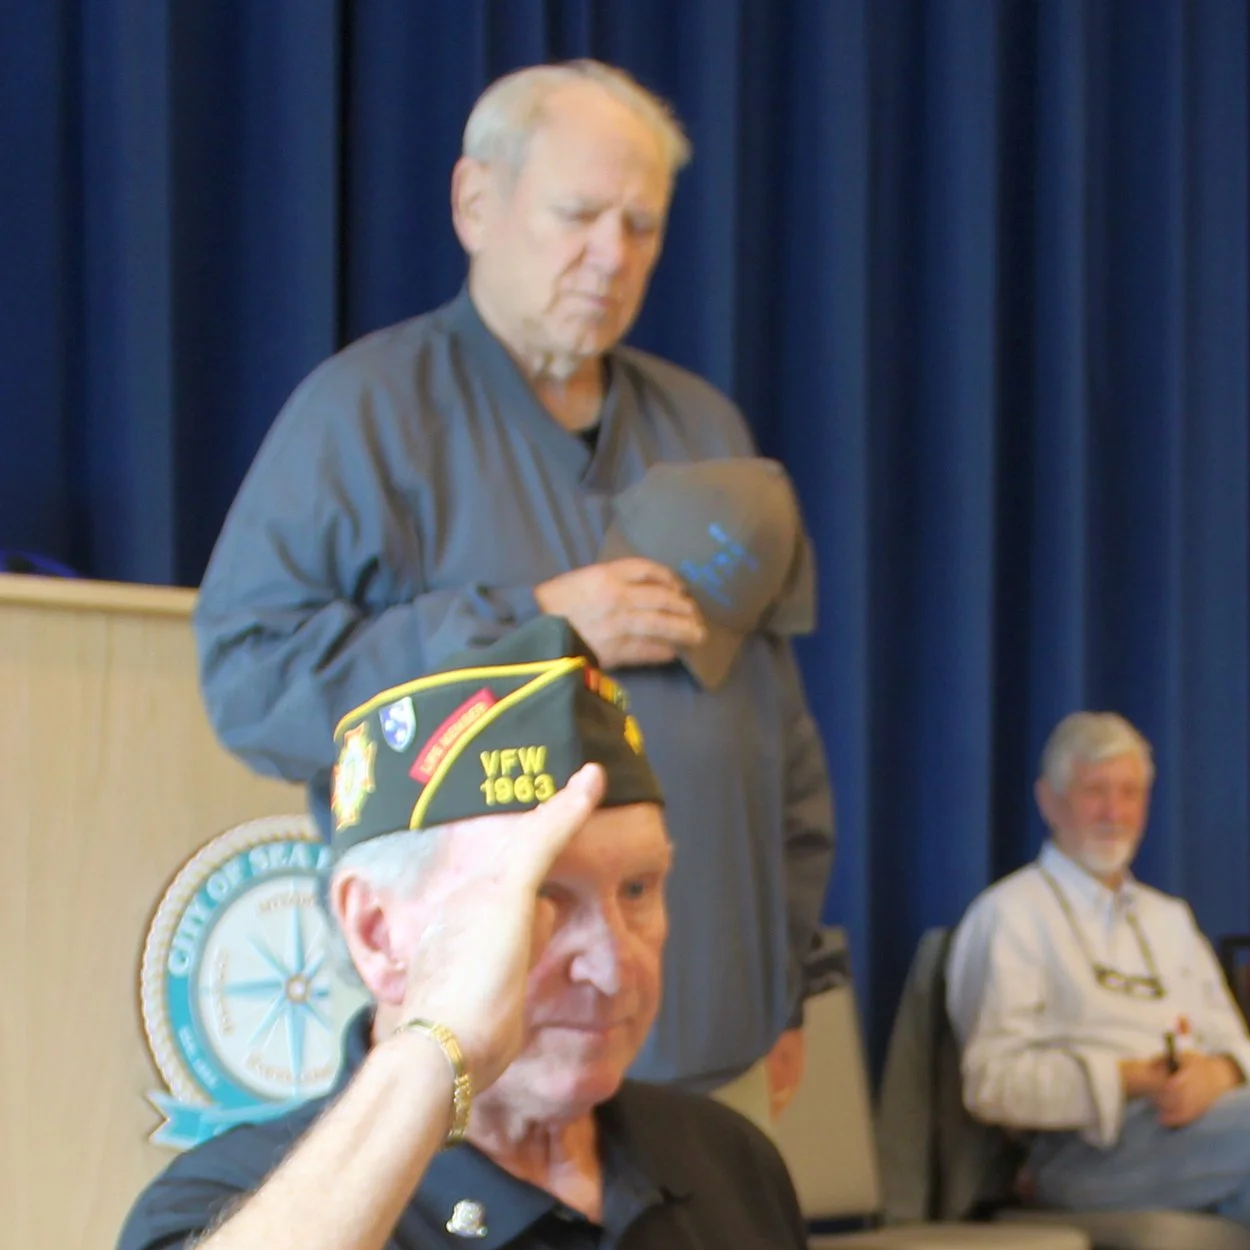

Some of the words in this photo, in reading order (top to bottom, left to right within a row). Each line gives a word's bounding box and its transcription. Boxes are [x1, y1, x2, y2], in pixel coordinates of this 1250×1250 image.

[480, 745, 547, 777] VFW
[480, 774, 556, 806] 1963
[167, 894, 209, 976] CITY
[206, 863, 242, 900] OF
[249, 843, 309, 876] SEA
